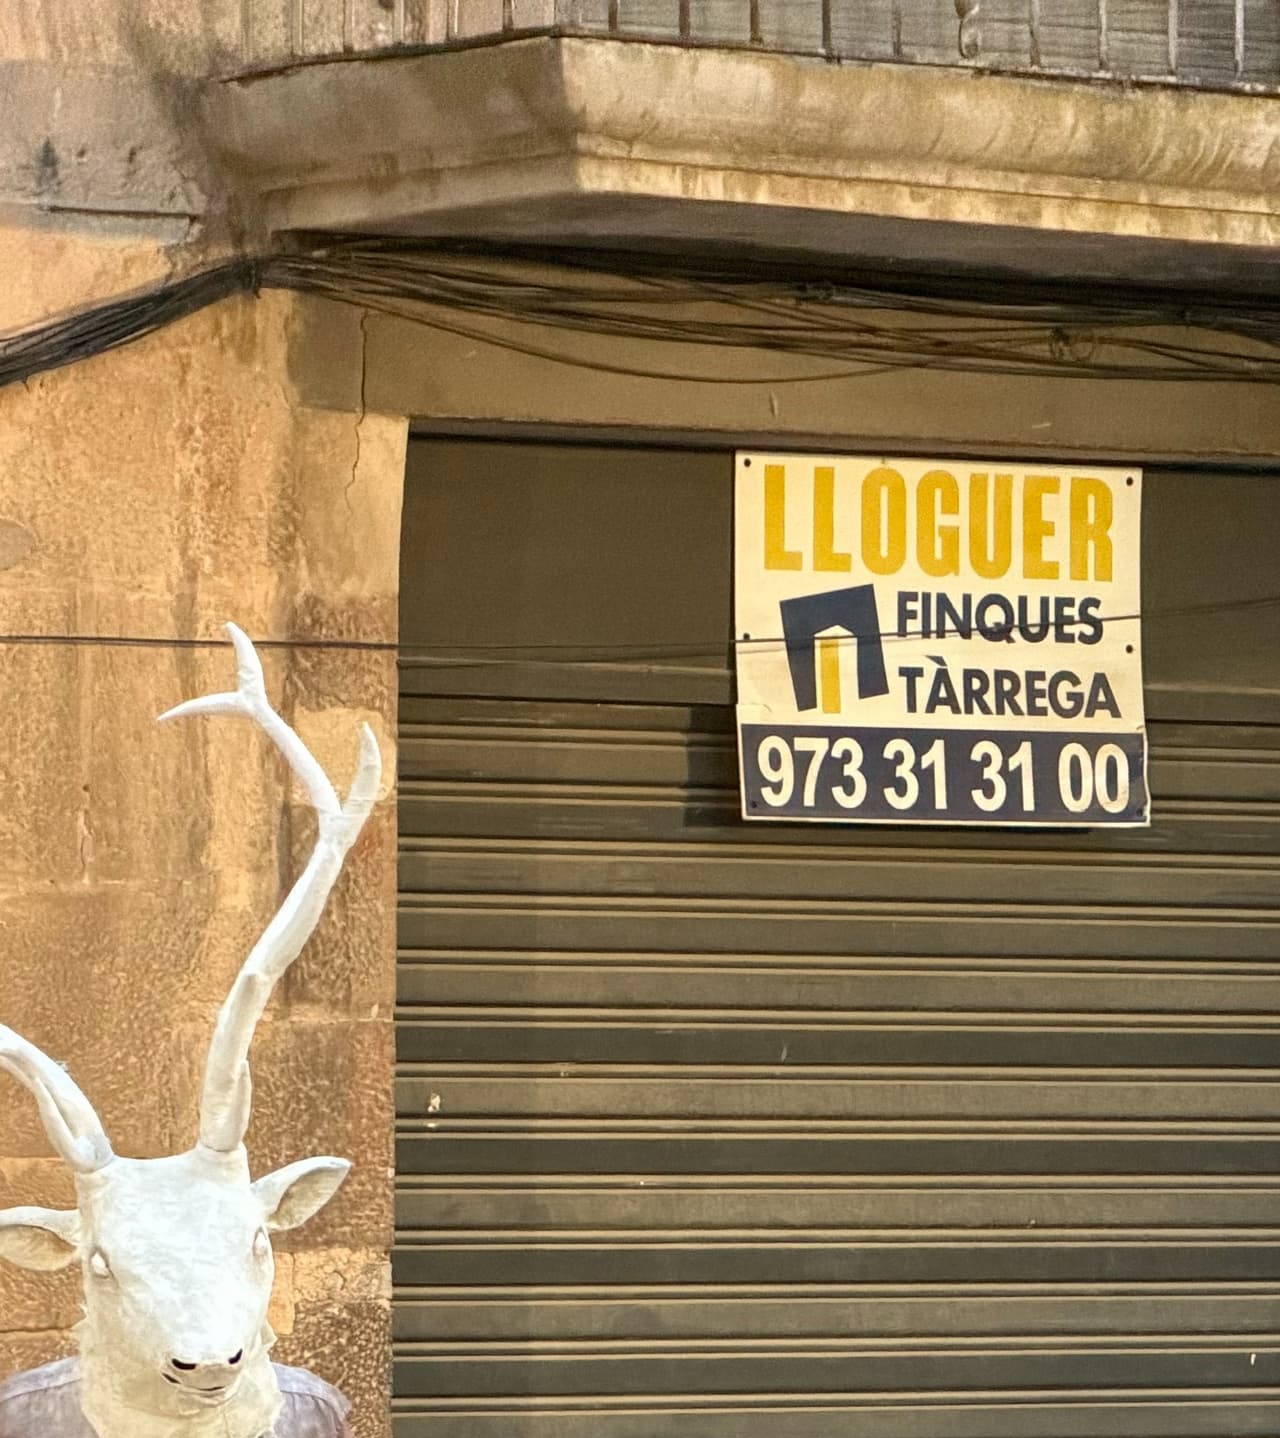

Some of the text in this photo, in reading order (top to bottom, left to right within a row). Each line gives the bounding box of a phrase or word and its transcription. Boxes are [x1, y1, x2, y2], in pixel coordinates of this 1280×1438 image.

[764, 464, 1113, 582] LLOGUER
[897, 590, 1104, 645] FINQUES
[898, 655, 1122, 719] TÀRREGA
[757, 735, 1129, 813] 973 31 31 00
